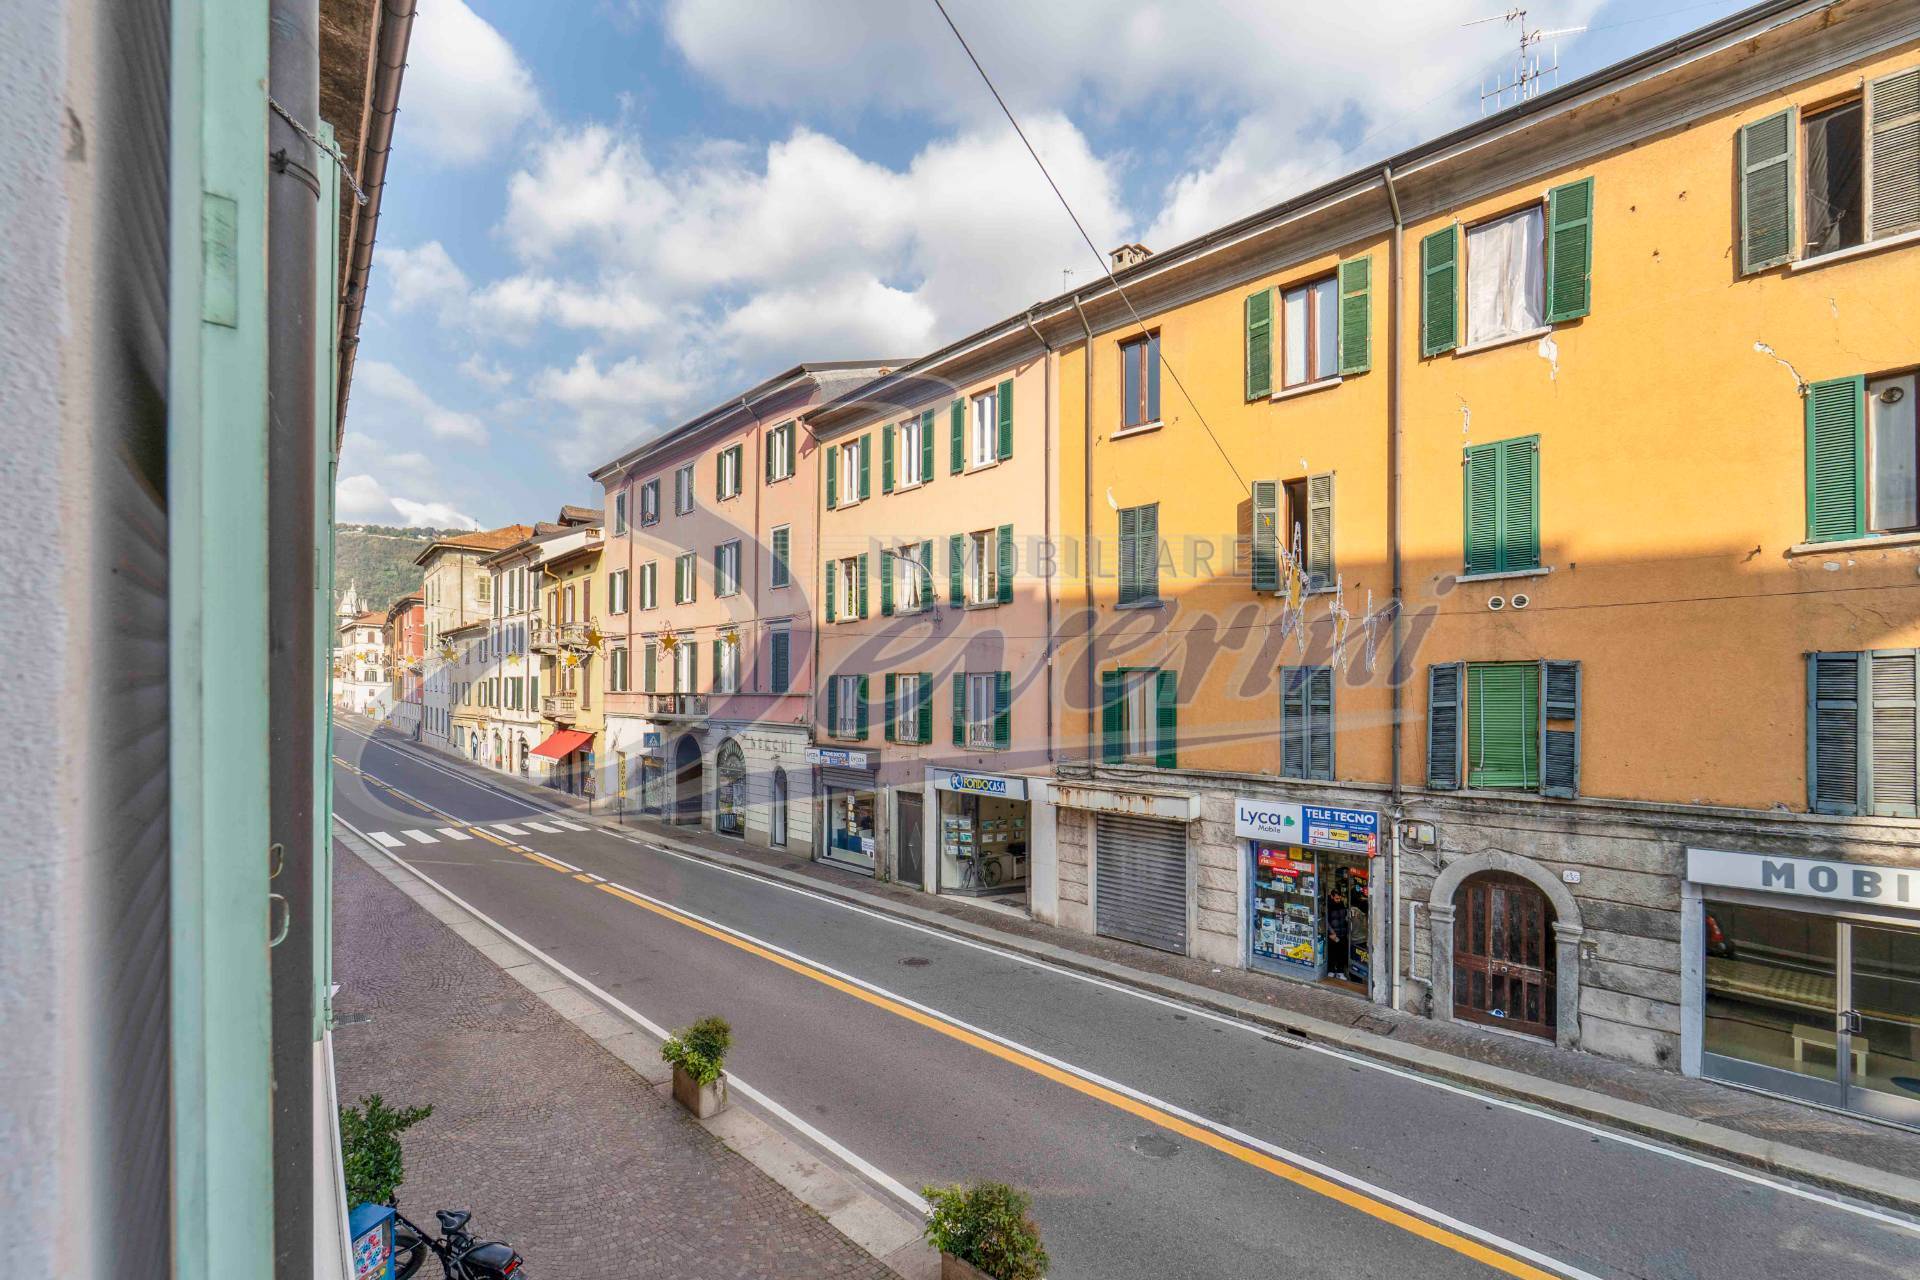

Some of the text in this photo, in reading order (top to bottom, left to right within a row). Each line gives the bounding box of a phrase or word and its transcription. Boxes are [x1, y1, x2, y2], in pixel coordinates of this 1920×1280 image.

[1240, 807, 1281, 826] Lyca
[1306, 808, 1375, 825] TELE TECNO
[1257, 825, 1281, 834] Mobile
[1762, 860, 1909, 902] MOBI
